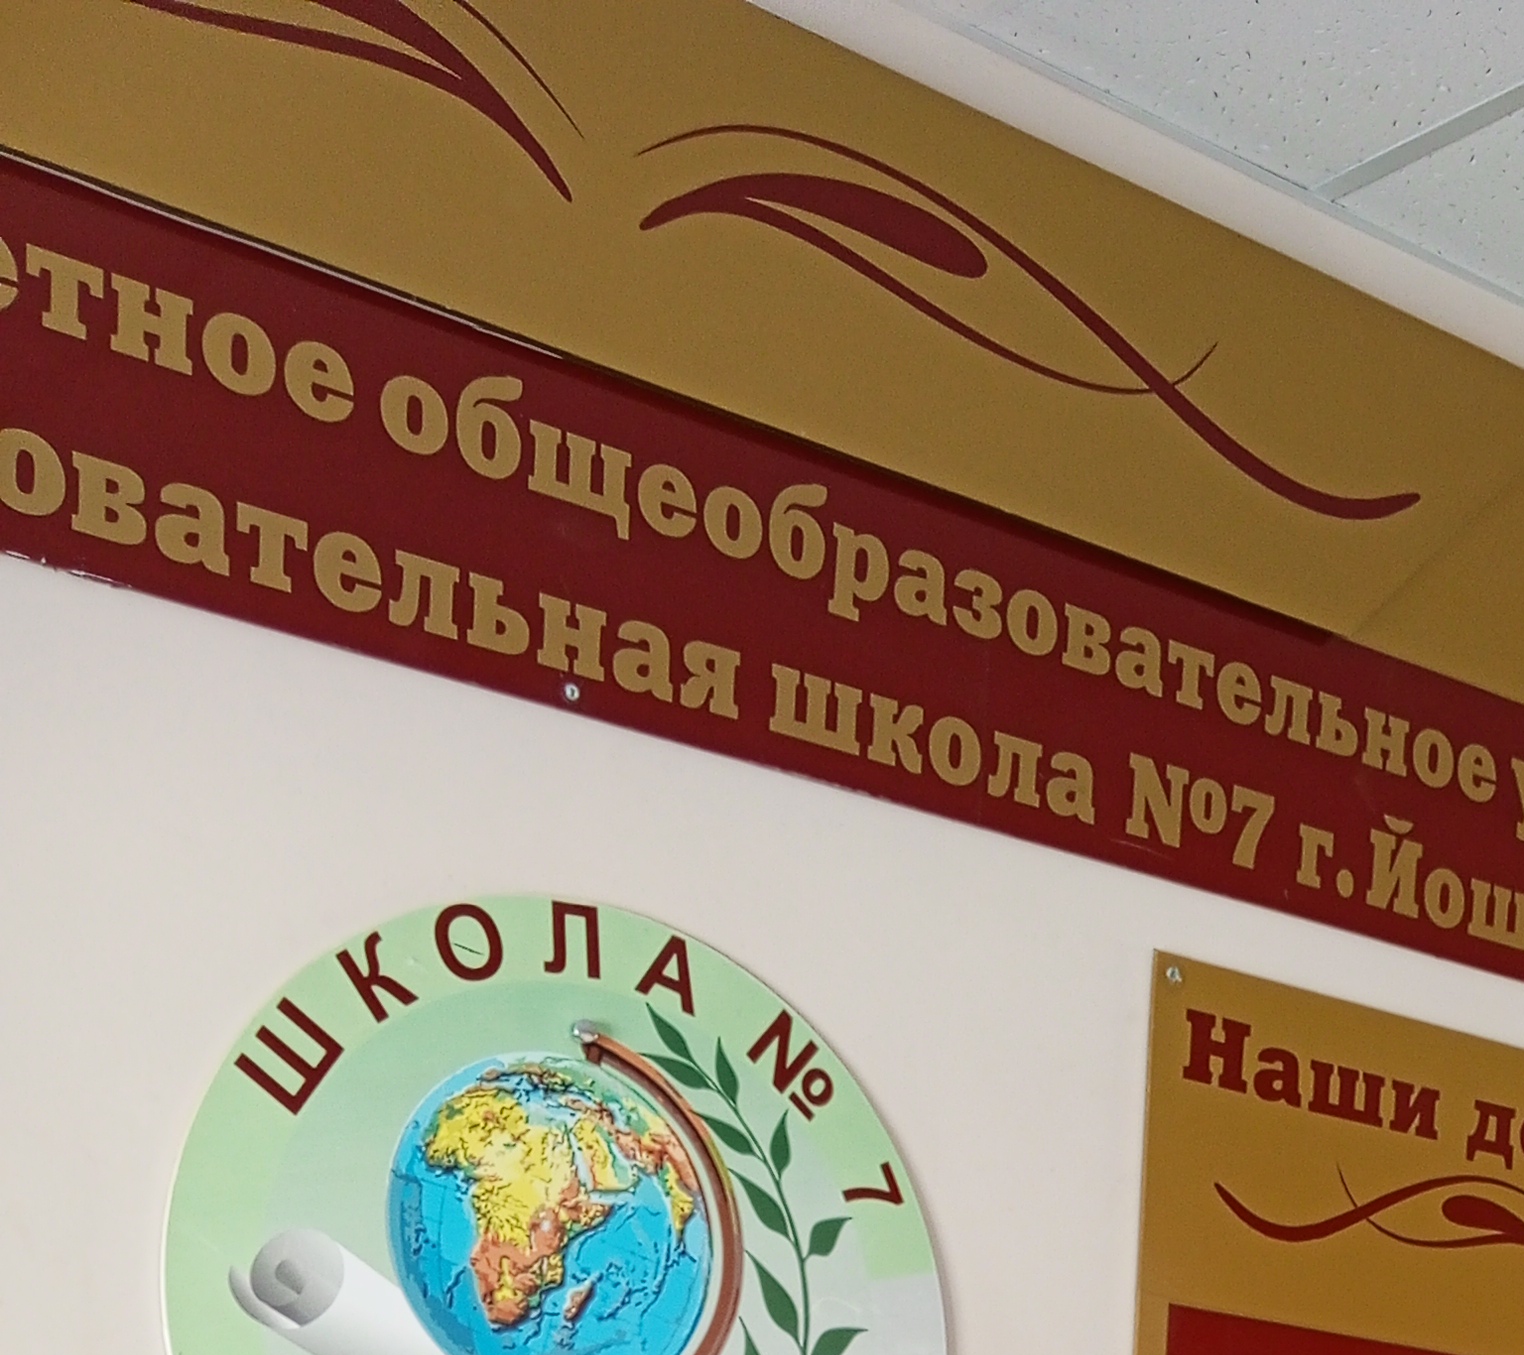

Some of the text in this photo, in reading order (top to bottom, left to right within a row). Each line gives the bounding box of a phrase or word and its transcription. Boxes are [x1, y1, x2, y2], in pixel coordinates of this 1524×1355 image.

[0, 237, 355, 423] тное
[380, 375, 1497, 803] общеобразовательное
[0, 427, 741, 720] овательная
[768, 662, 1095, 826] школа
[232, 899, 905, 1209] ШКОЛА № 7
[1182, 1008, 1440, 1141] Наши
